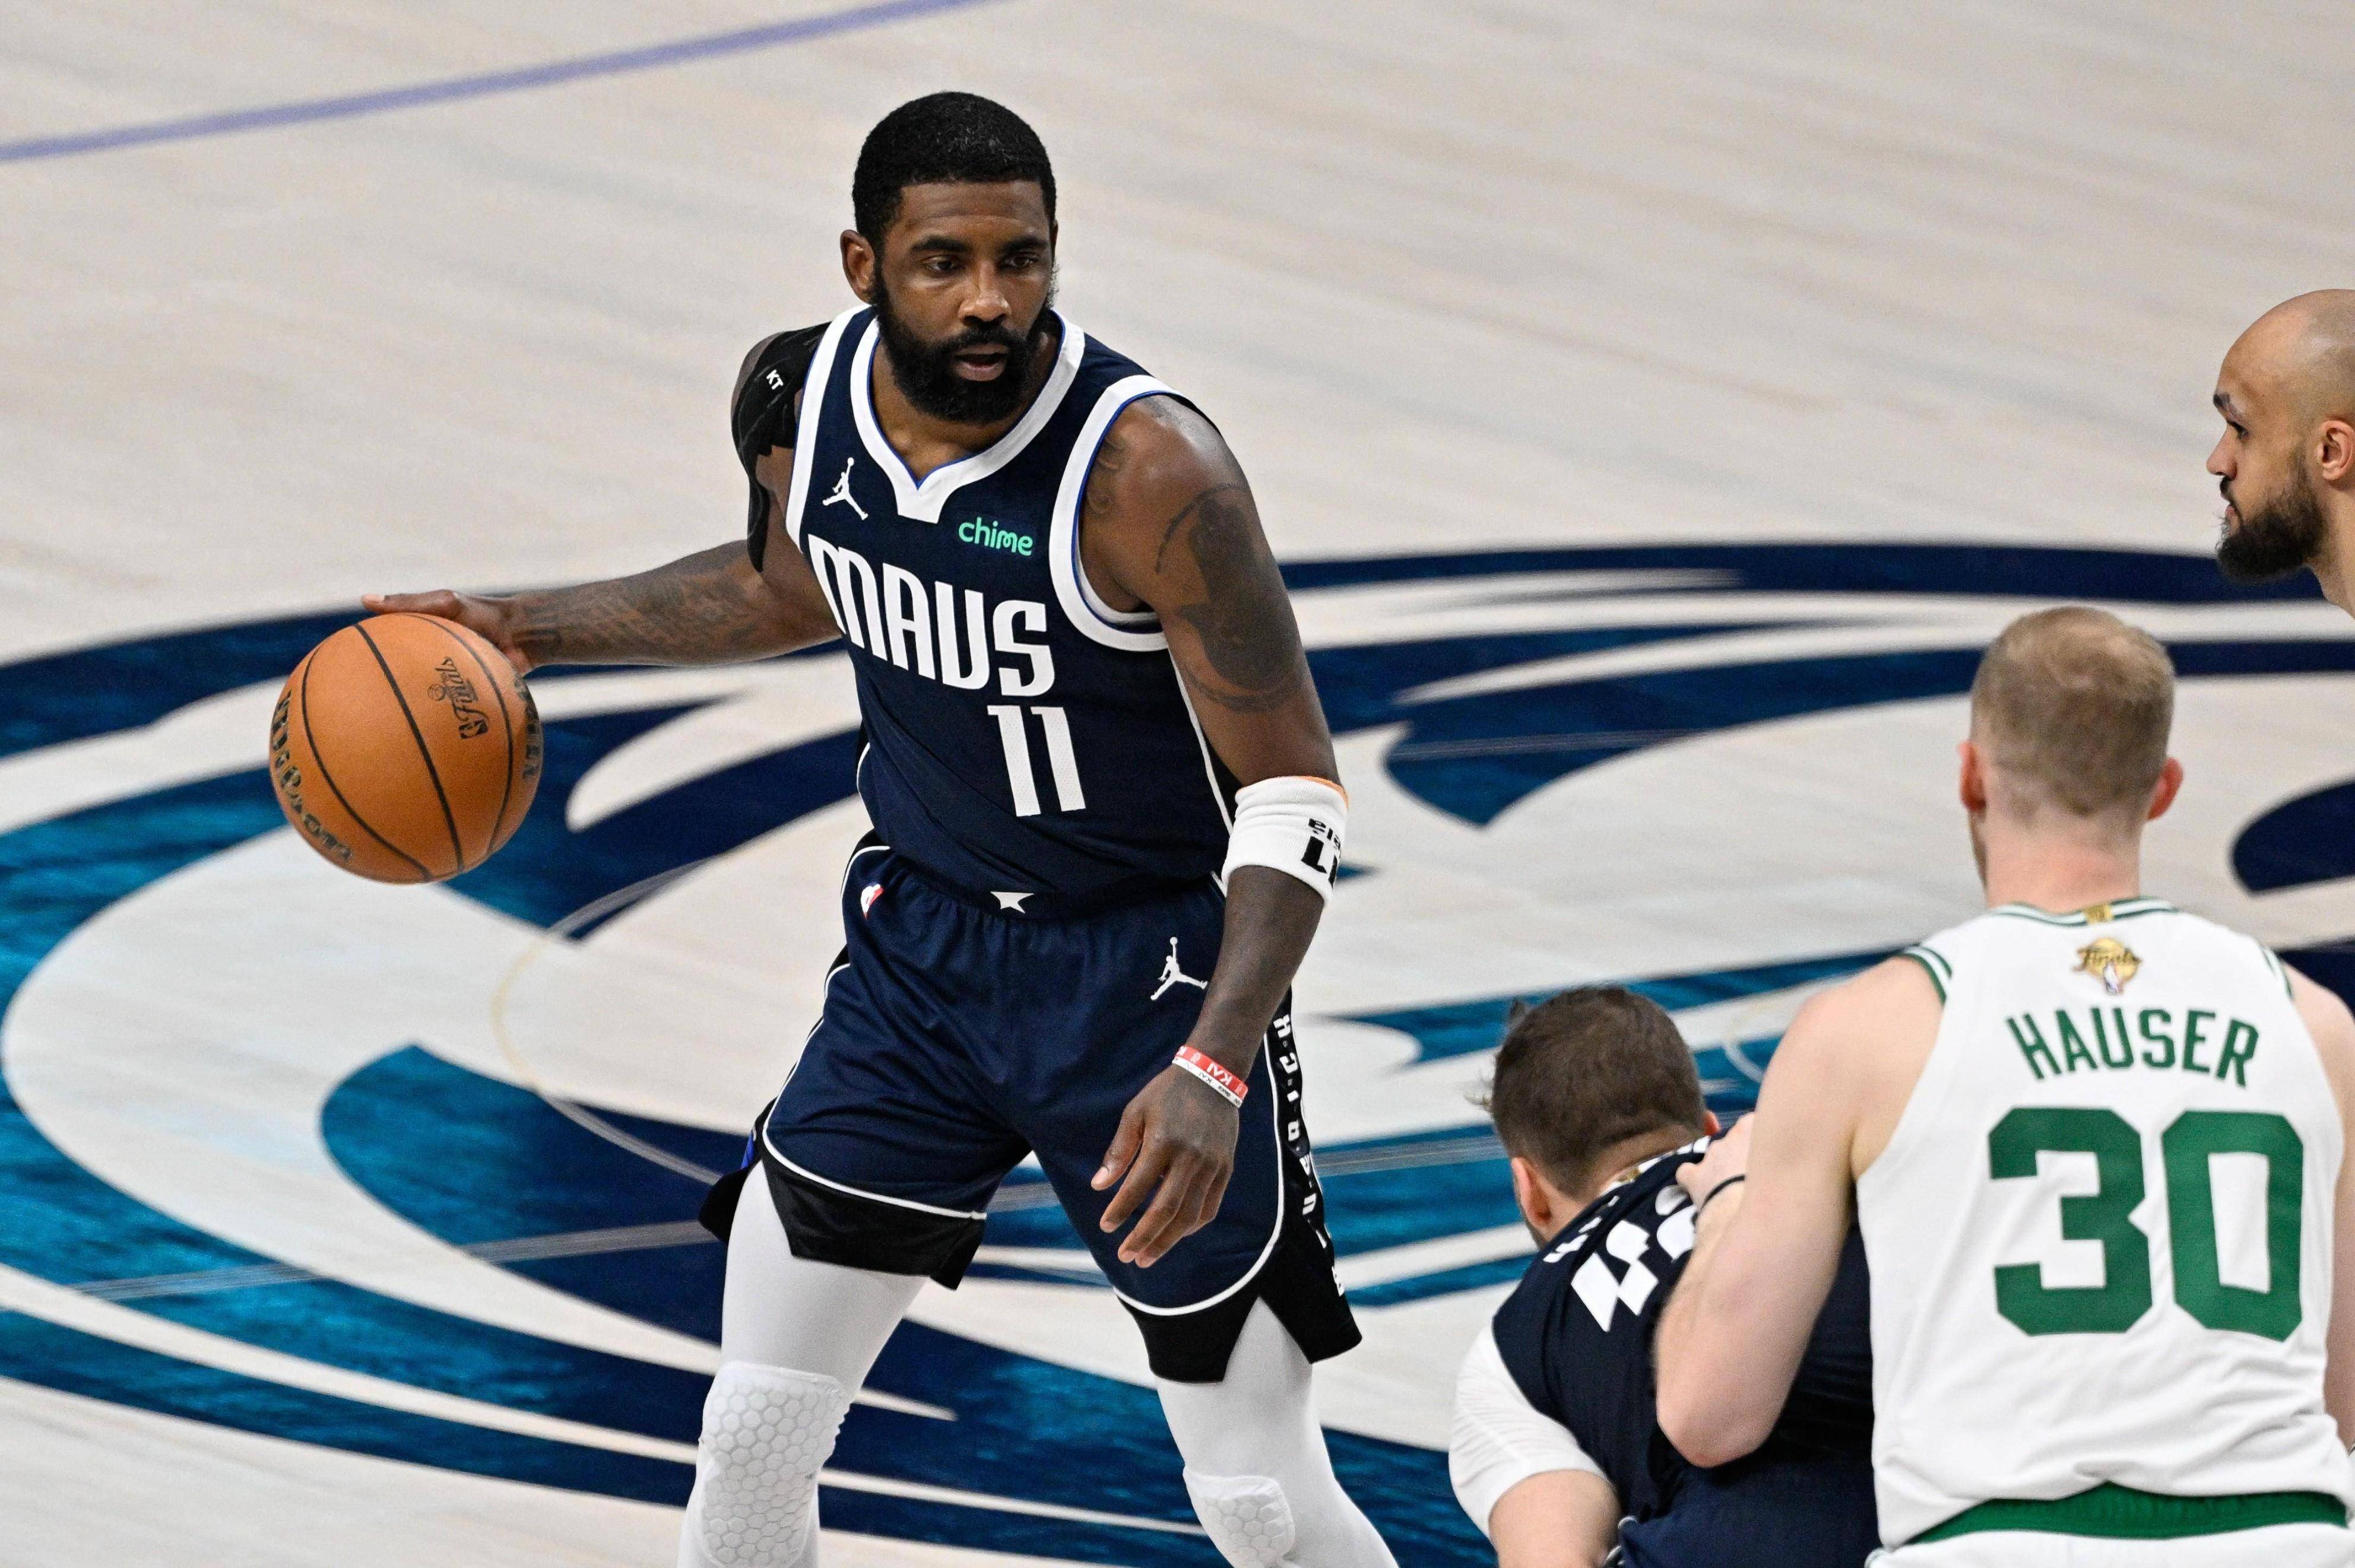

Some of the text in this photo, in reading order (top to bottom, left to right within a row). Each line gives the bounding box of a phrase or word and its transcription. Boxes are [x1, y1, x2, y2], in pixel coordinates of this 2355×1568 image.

[766, 369, 784, 390] KT
[958, 517, 1034, 557] chime
[808, 534, 1056, 697] MAVS
[987, 706, 1086, 818] 11
[2007, 1006, 2259, 1088] HAUSER
[1988, 1107, 2305, 1342] 30
